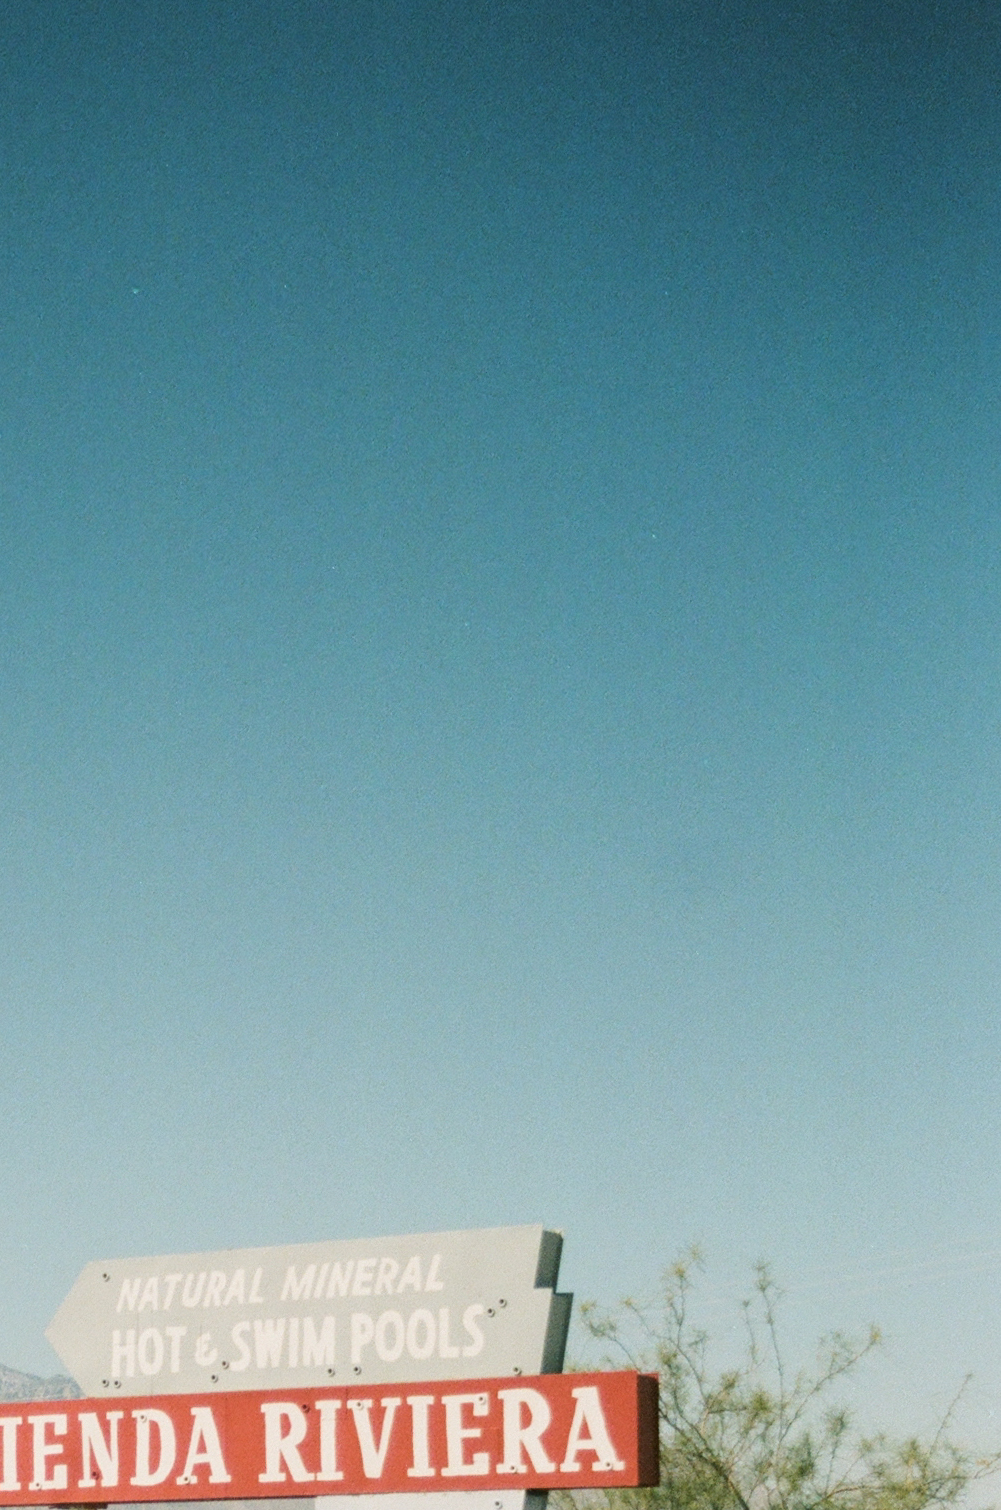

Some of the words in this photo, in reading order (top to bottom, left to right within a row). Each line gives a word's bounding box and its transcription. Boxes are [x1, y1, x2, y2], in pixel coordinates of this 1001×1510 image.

[116, 1267, 264, 1313] NATURAL
[280, 1254, 444, 1301] MINERAL
[111, 1325, 188, 1377] HOT
[230, 1315, 336, 1372] SWIM
[351, 1303, 485, 1364] POOLS
[258, 1386, 625, 1483] RIVIERA
